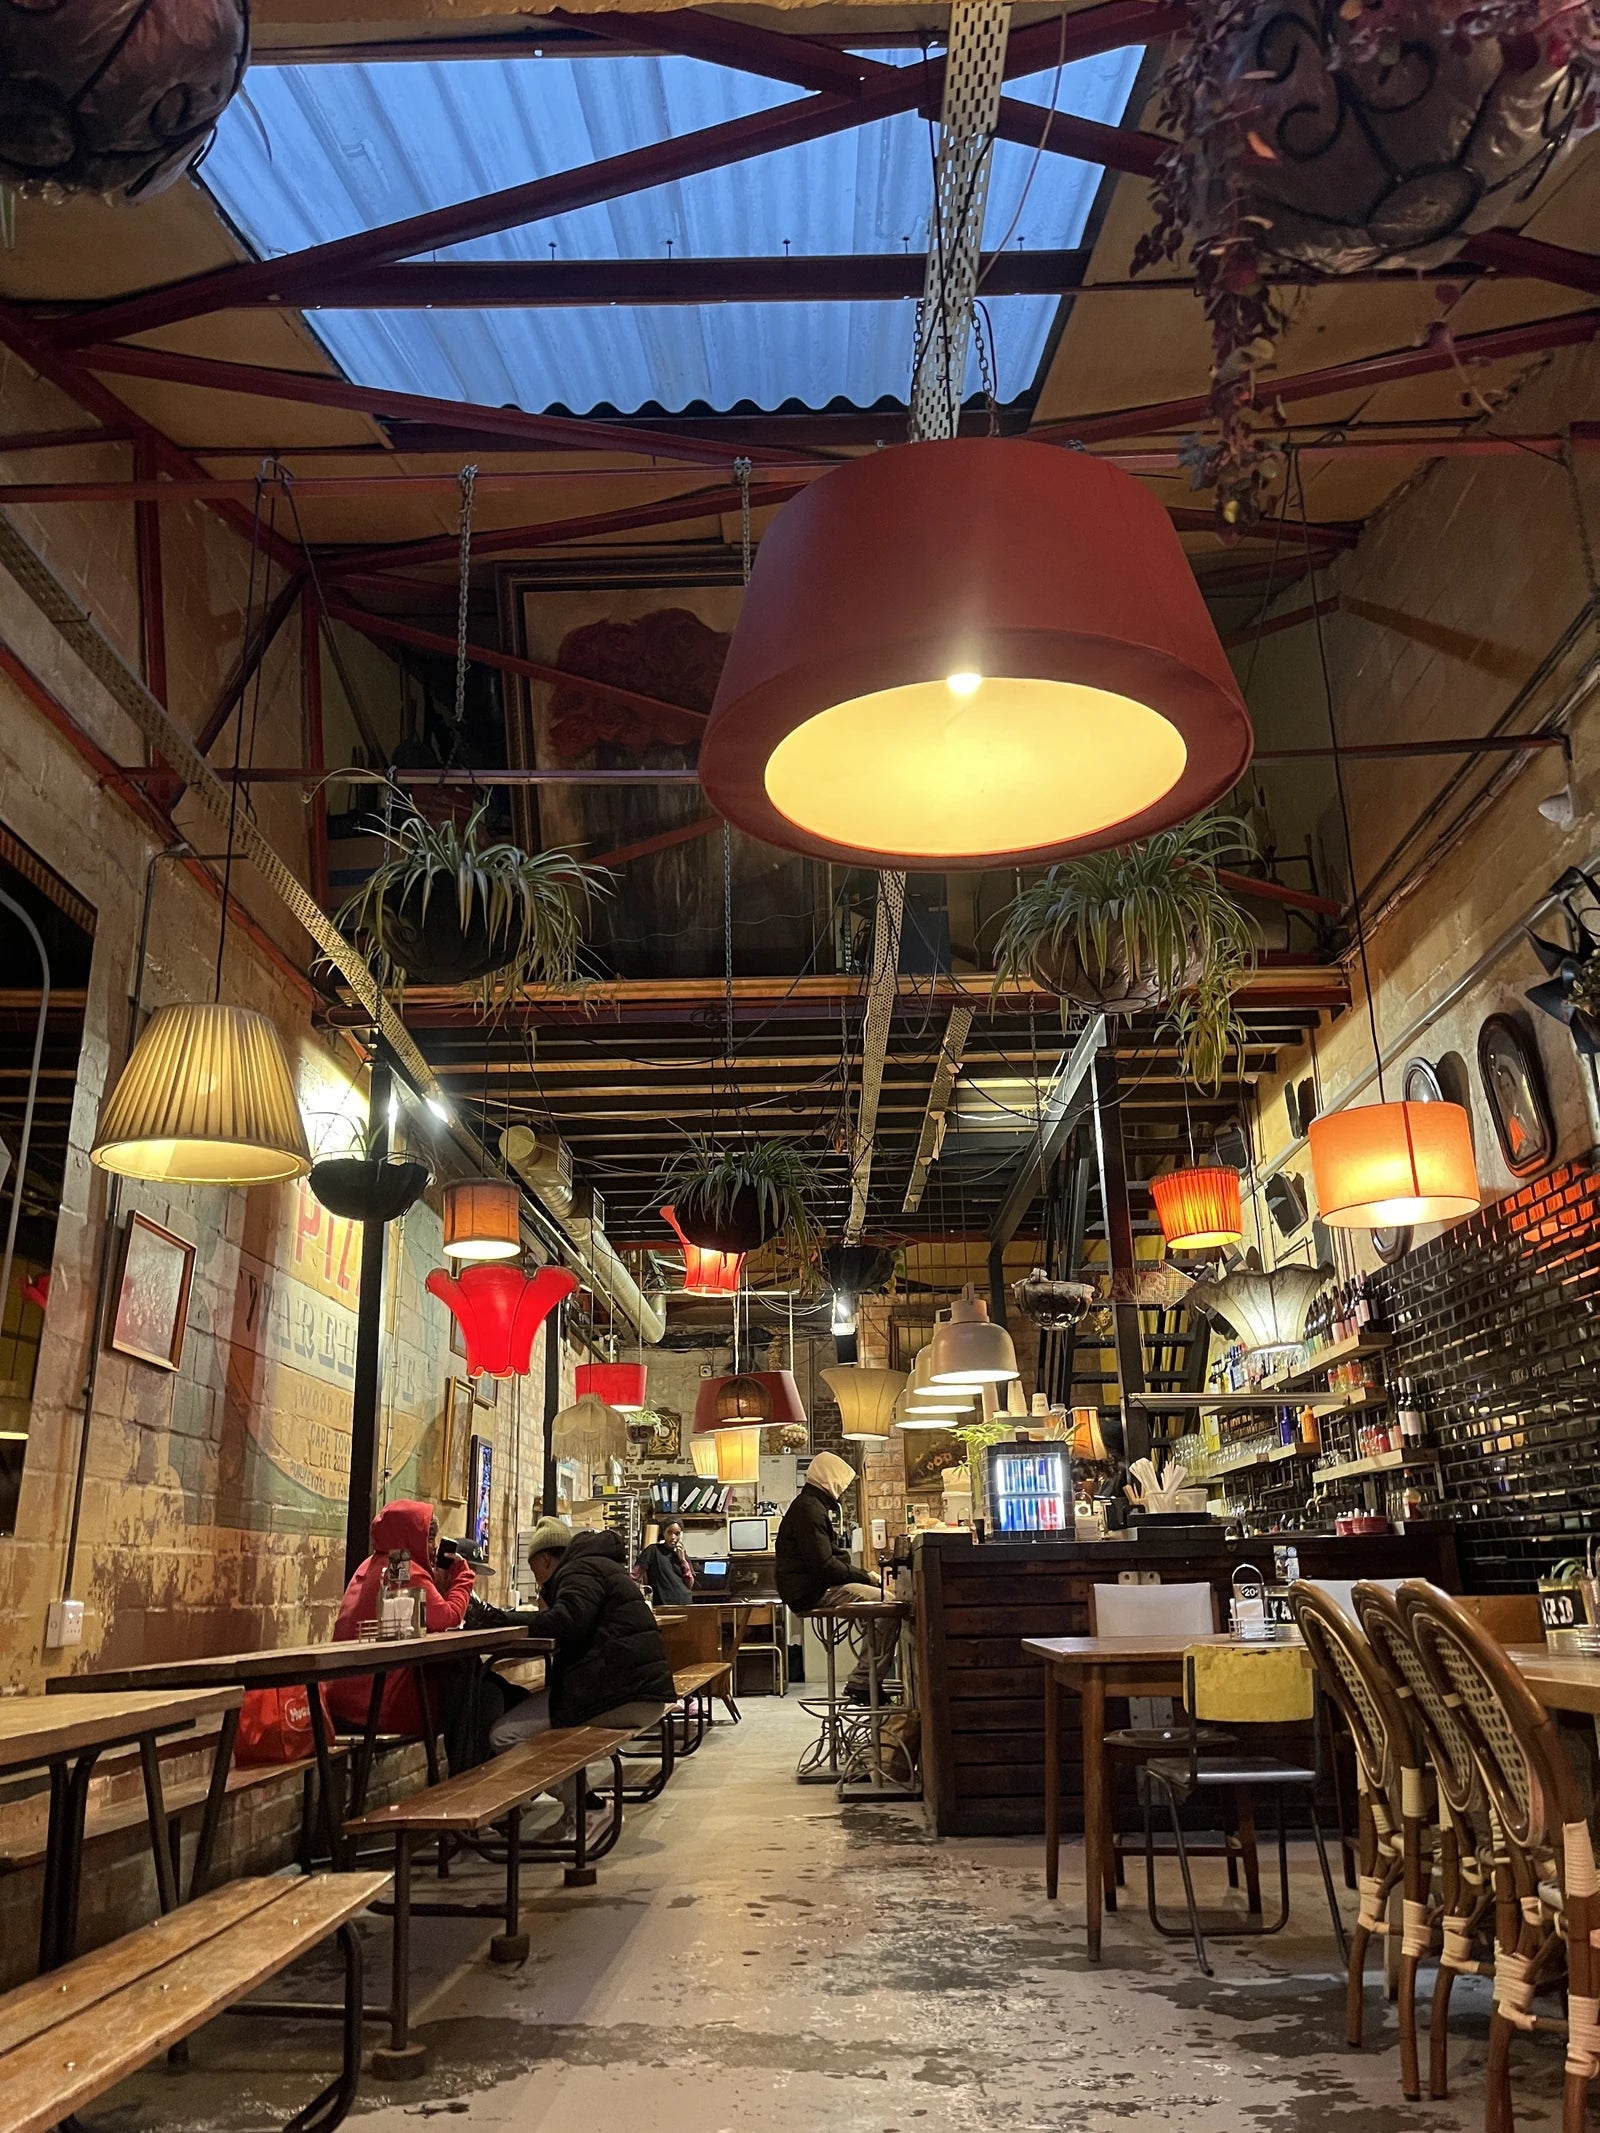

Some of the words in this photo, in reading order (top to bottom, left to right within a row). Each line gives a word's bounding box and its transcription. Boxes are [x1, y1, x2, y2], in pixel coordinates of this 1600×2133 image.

[294, 1176, 360, 1298] PIZ
[300, 1384, 332, 1416] WOOD
[310, 1423, 329, 1451] CAPE
[1269, 1600, 1295, 1620] YA
[1541, 1595, 1575, 1625] RD
